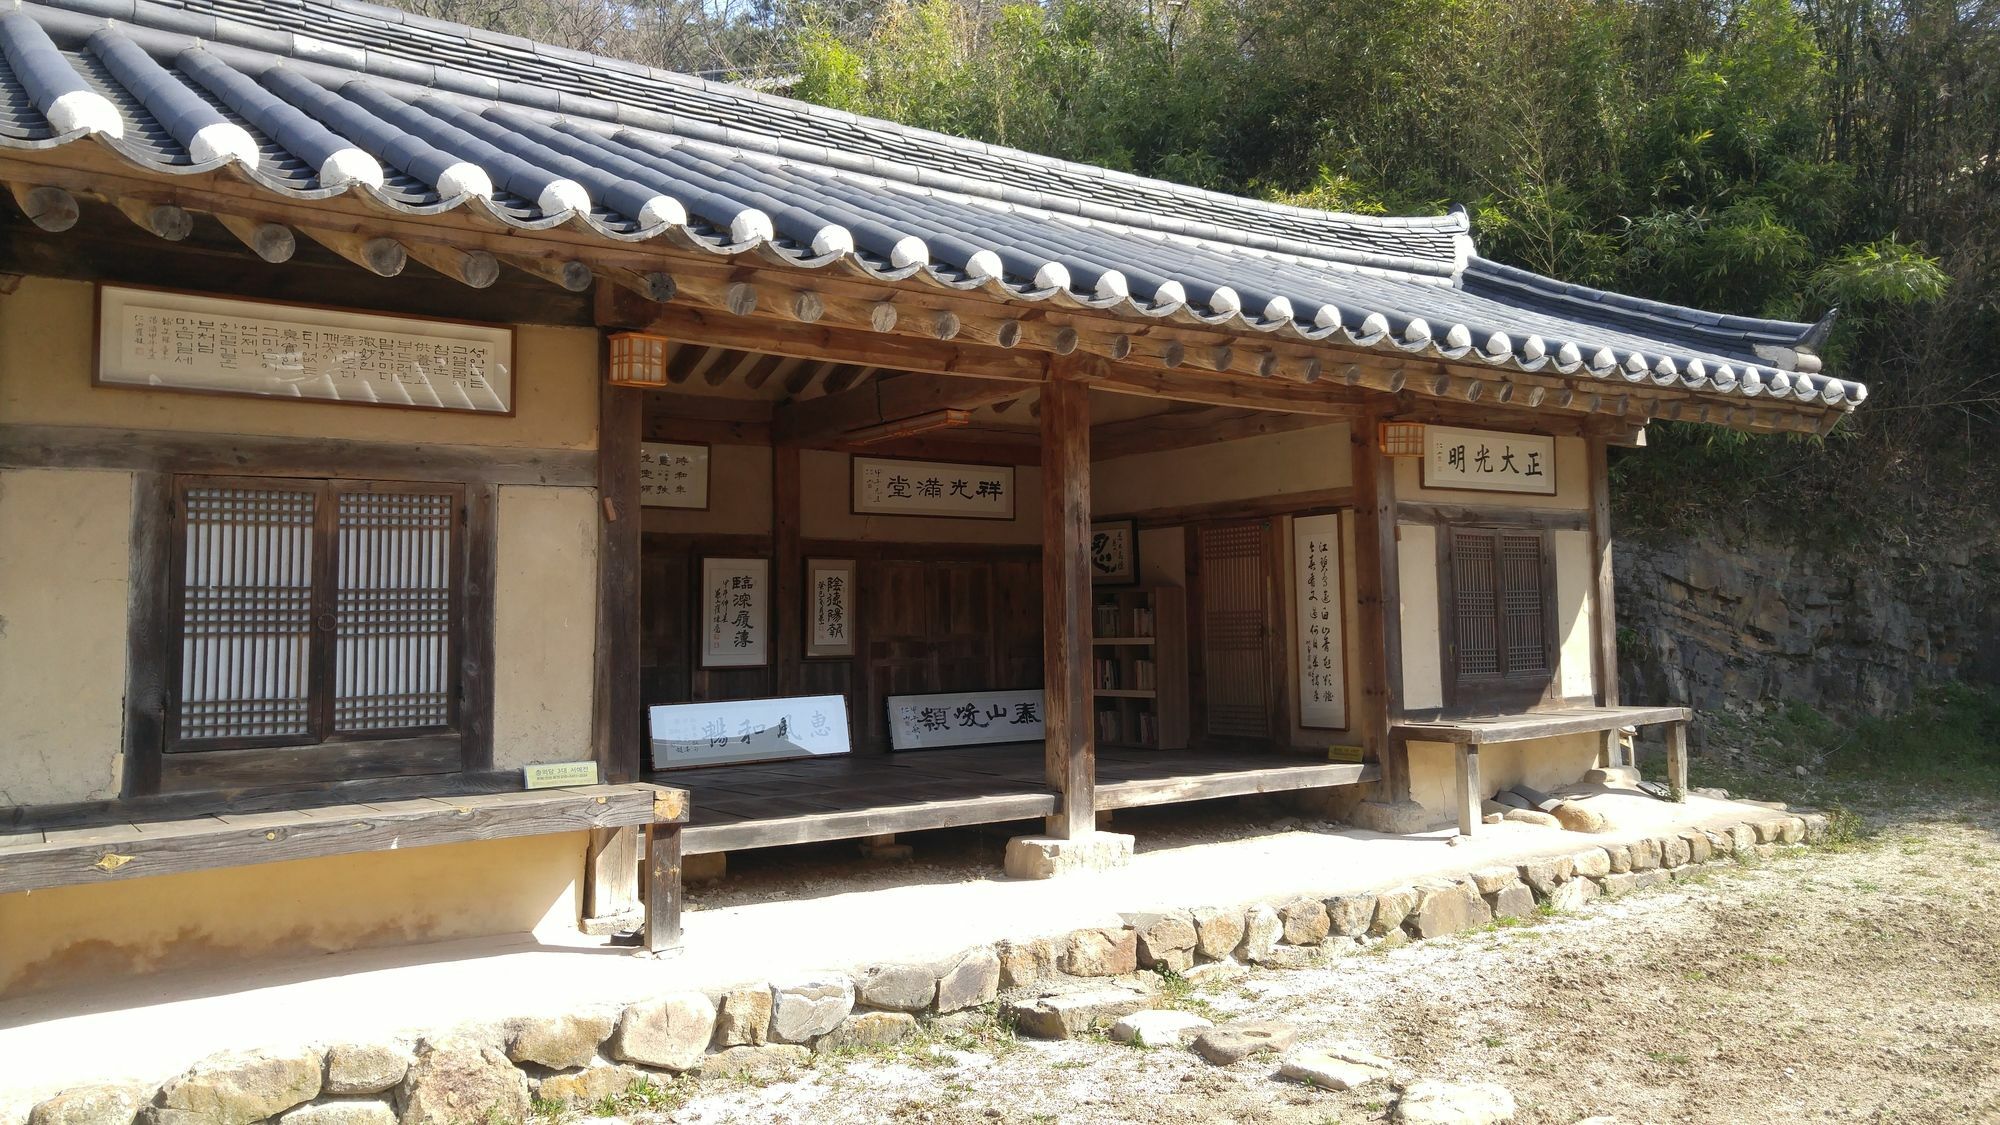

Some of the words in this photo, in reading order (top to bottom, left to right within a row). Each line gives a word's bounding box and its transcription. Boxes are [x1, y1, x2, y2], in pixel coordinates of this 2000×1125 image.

[174, 317, 194, 366] 마음일세
[197, 320, 214, 354] 부처님
[241, 324, 259, 356] 언제나
[378, 338, 394, 382] 말한마디
[1448, 444, 1543, 477] 正大光明
